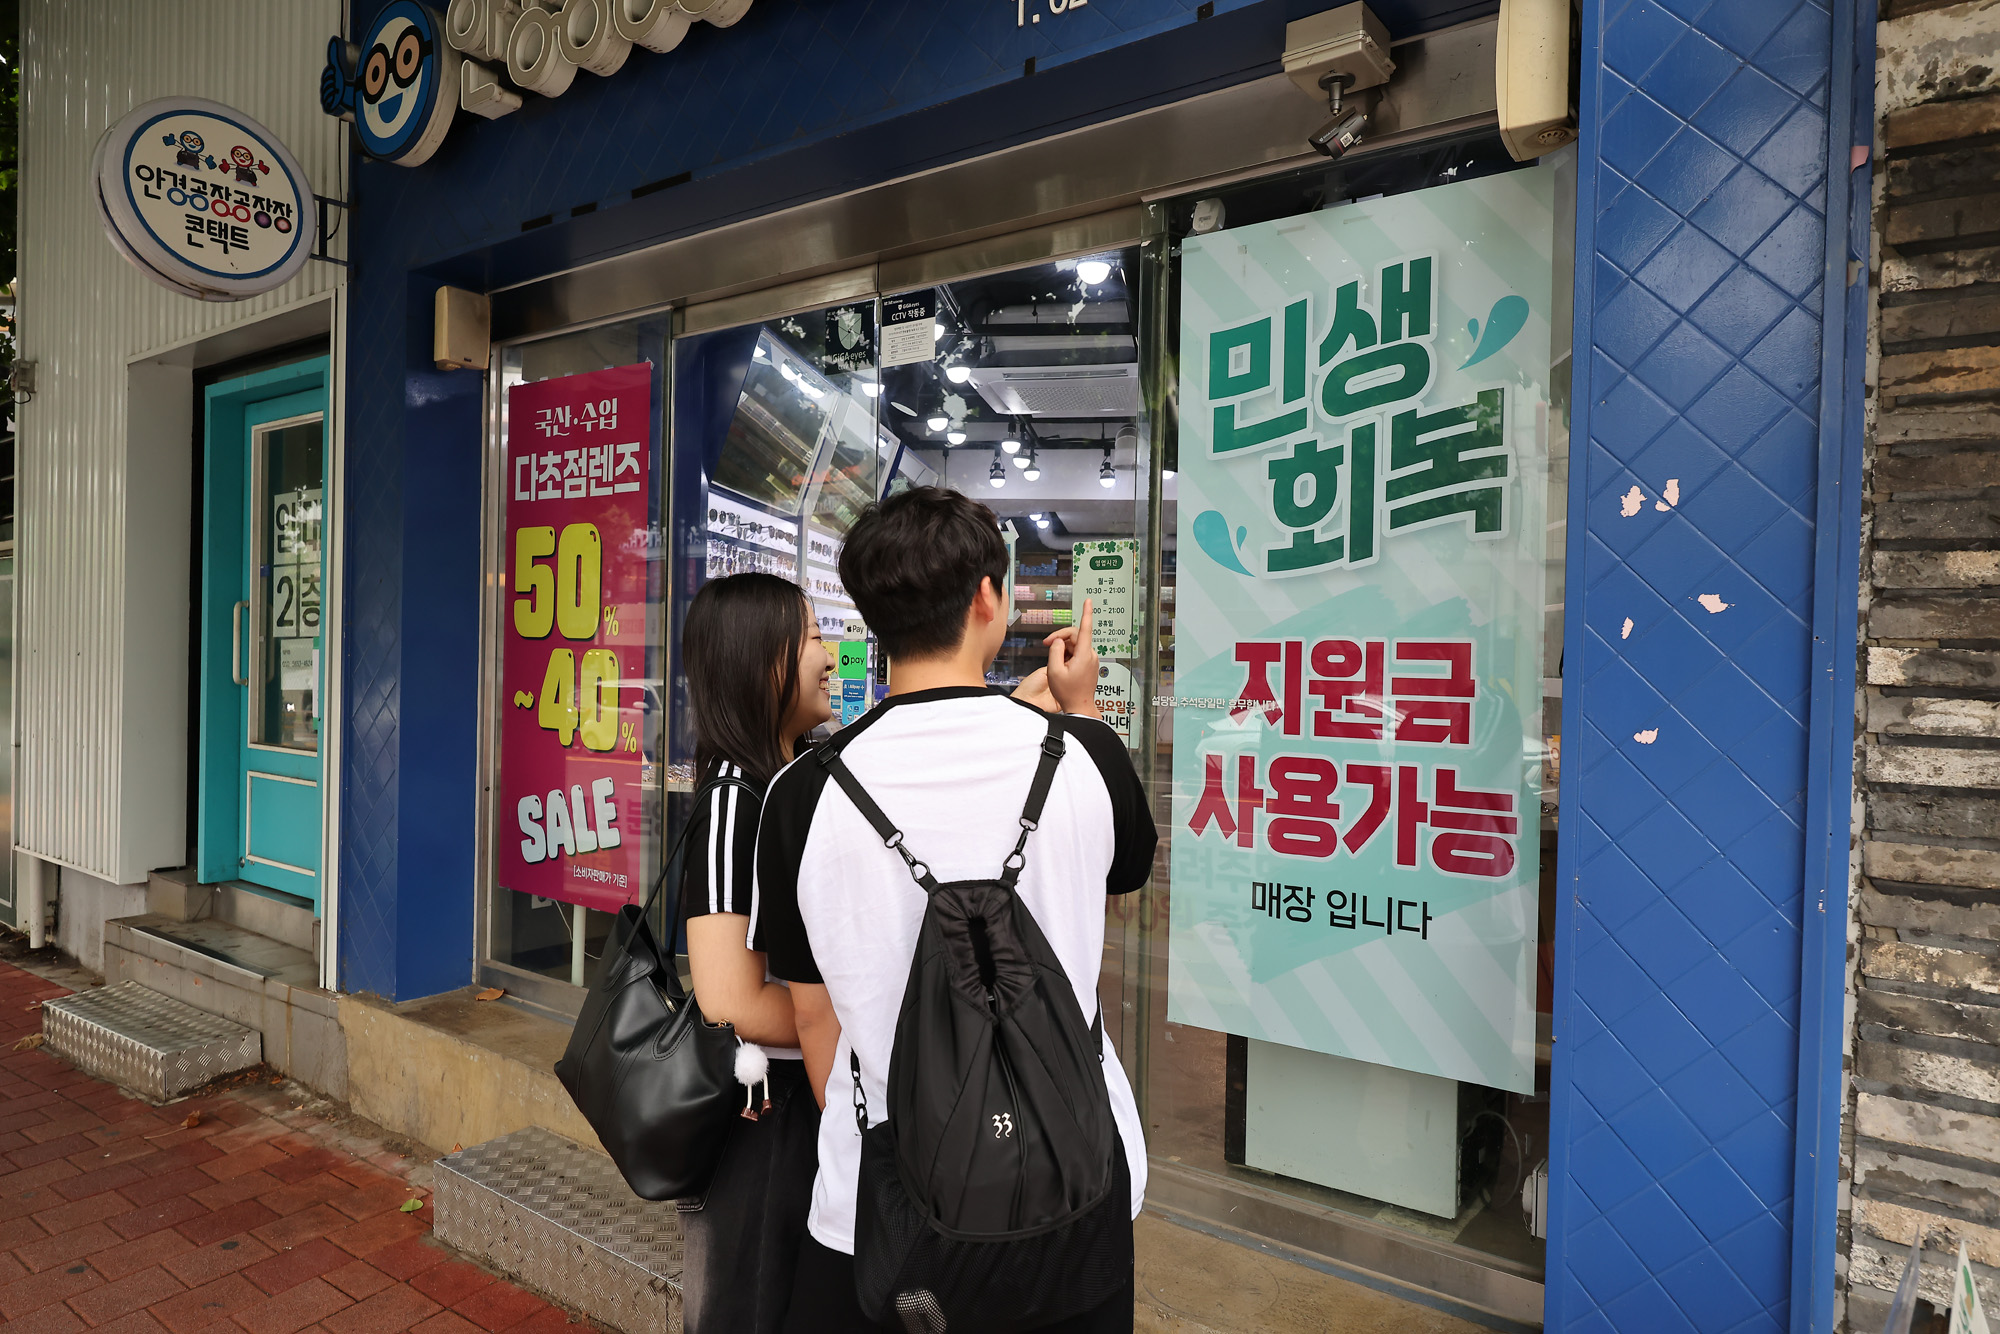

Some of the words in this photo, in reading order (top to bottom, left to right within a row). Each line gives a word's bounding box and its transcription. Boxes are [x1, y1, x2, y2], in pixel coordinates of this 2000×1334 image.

[184, 213, 250, 255] 콘택트
[891, 311, 907, 321] CCTV
[907, 307, 926, 318] 작동중
[1208, 256, 1432, 454] 민생
[514, 441, 641, 502] 다초점렌즈
[1267, 387, 1508, 573] 회복
[1085, 587, 1102, 595] 10:30
[1108, 586, 1126, 594] 21:00
[1095, 559, 1118, 567] 영업시간
[276, 573, 321, 628] 2층
[852, 625, 864, 634] Pay
[1108, 628, 1126, 636] 20:00
[850, 657, 865, 665] pay
[1229, 639, 1476, 745] 지원금
[517, 776, 621, 865] SALE
[1187, 754, 1518, 878] 사용가능
[1252, 881, 1316, 923] 매장
[1326, 889, 1433, 941] 입니다
